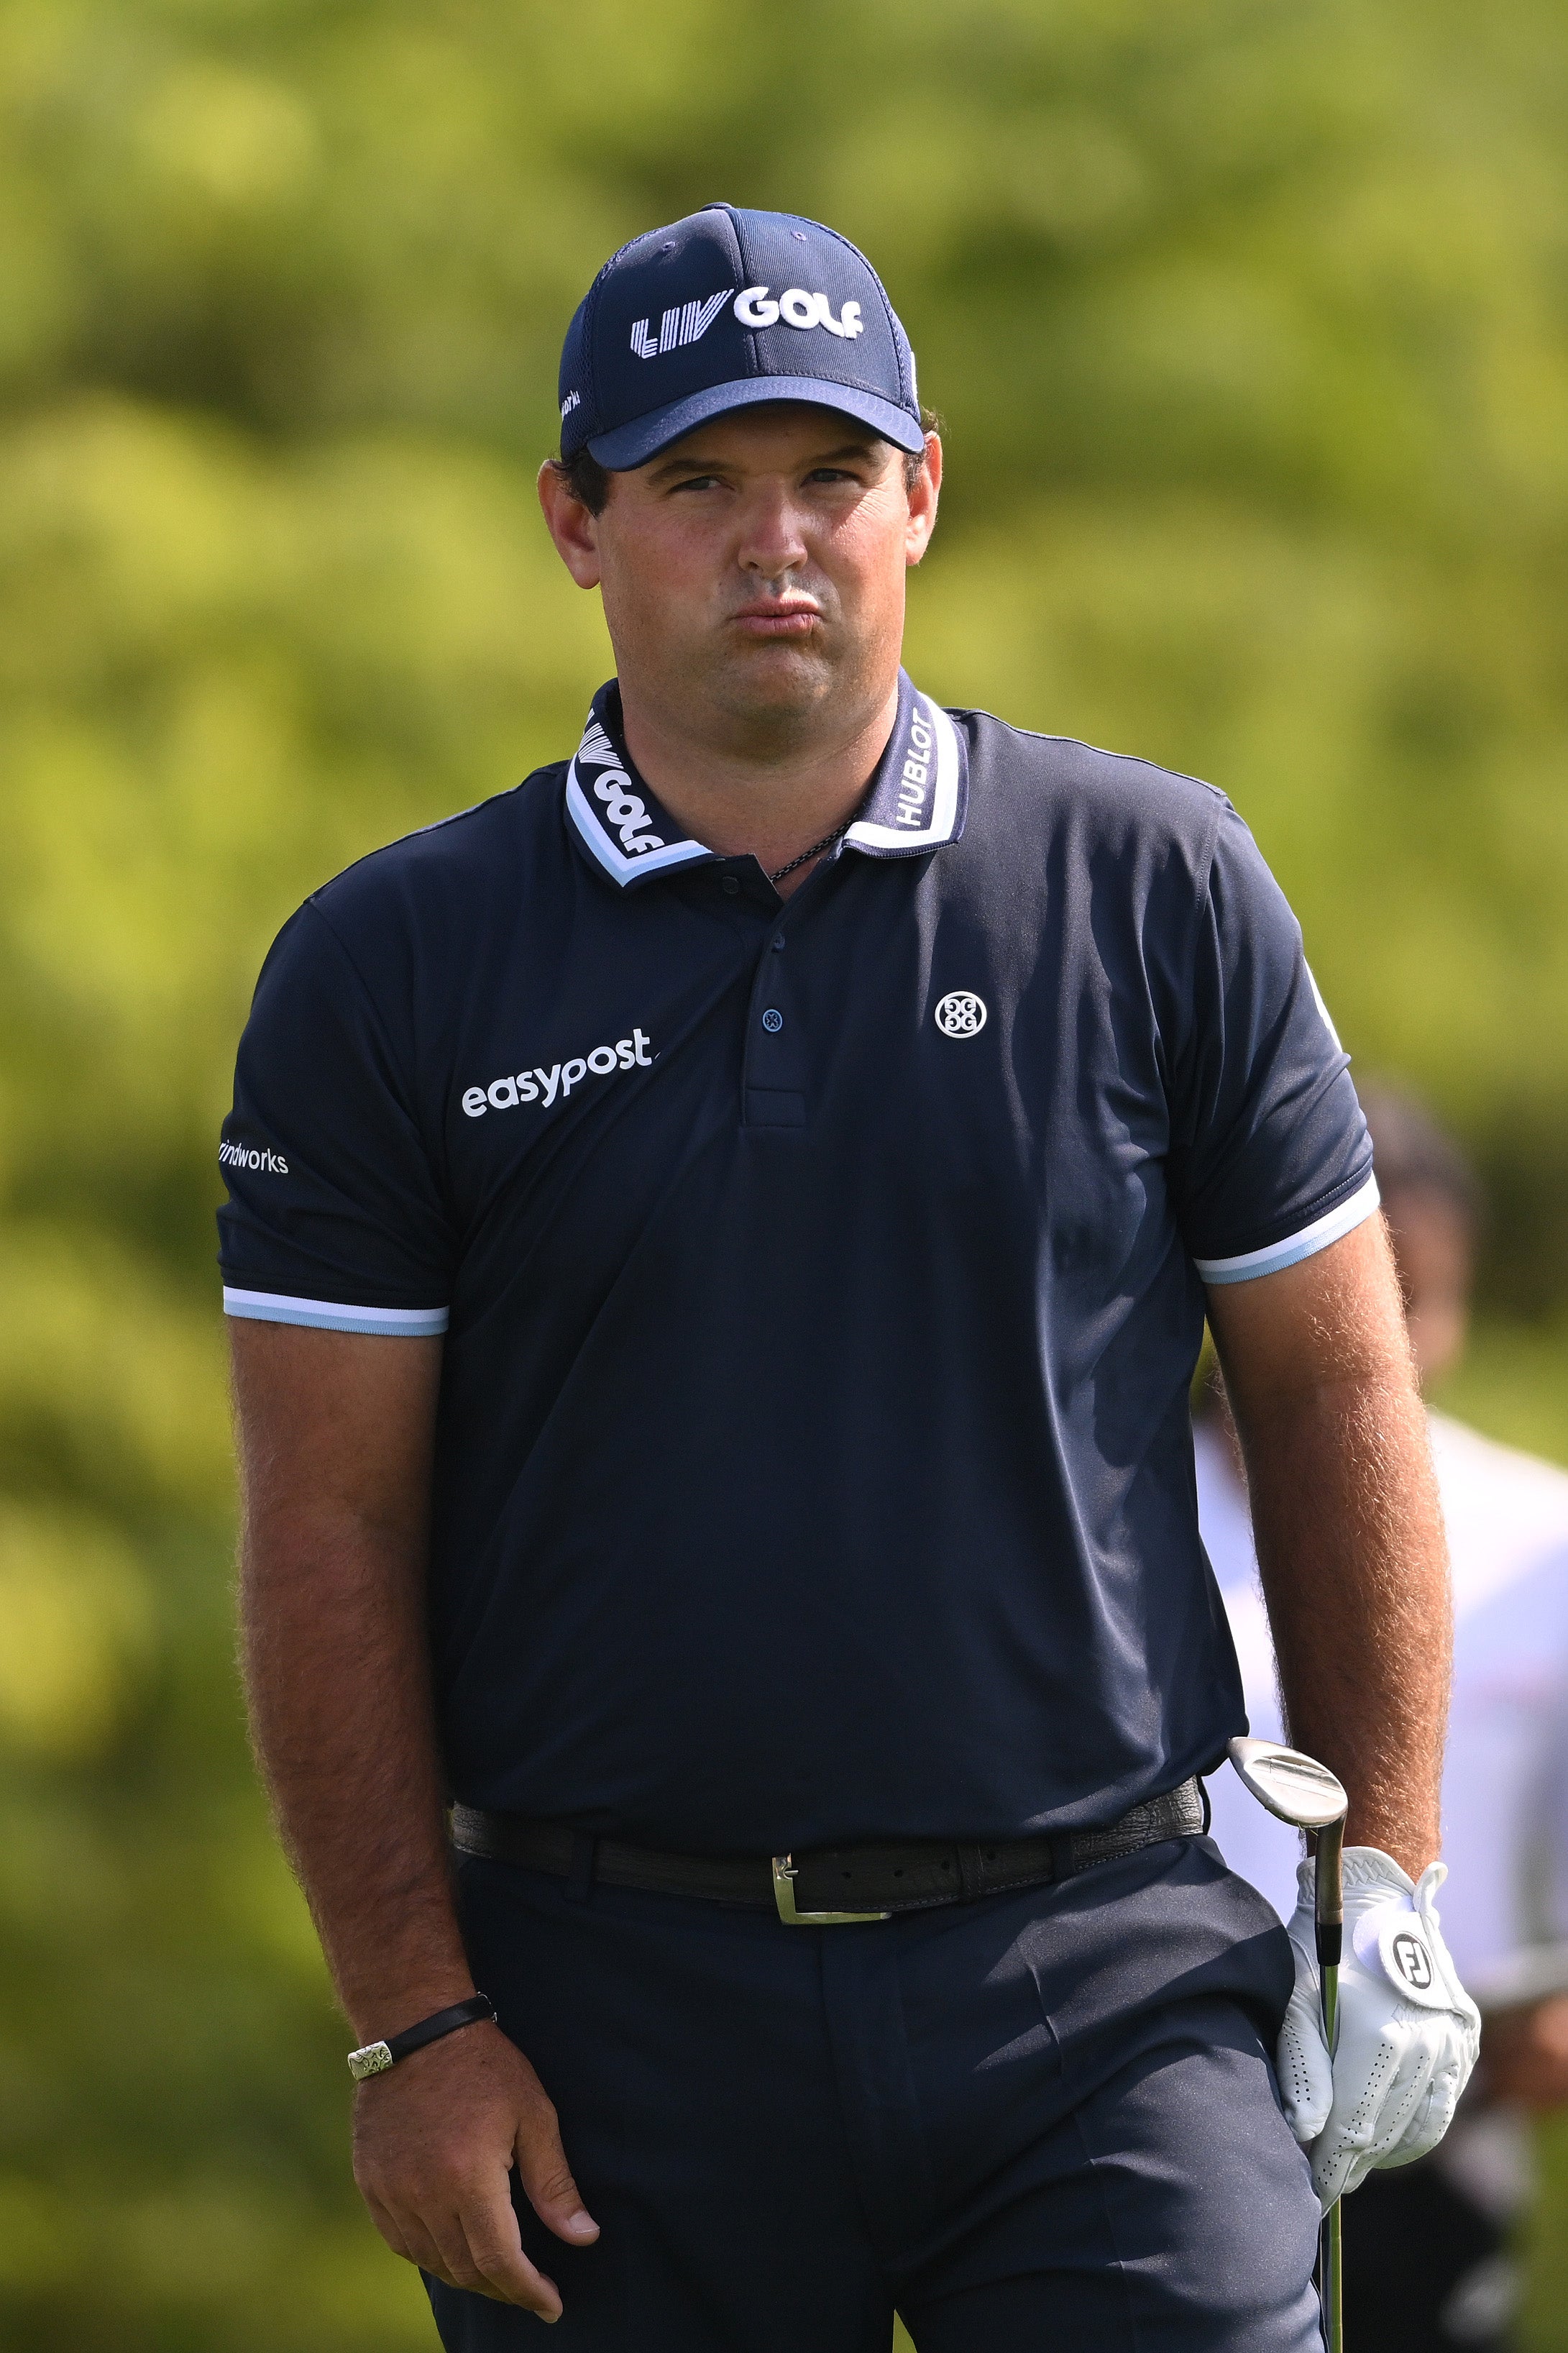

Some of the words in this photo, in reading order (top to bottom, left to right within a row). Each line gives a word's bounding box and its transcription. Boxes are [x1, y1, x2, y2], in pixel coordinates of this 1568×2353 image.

[630, 288, 735, 359] LIV
[733, 286, 863, 339] GOLF
[896, 707, 932, 827] HUBLOT
[593, 769, 665, 854] GOLF
[462, 1028, 653, 1118] easypost
[1396, 1941, 1431, 1983] FJ
